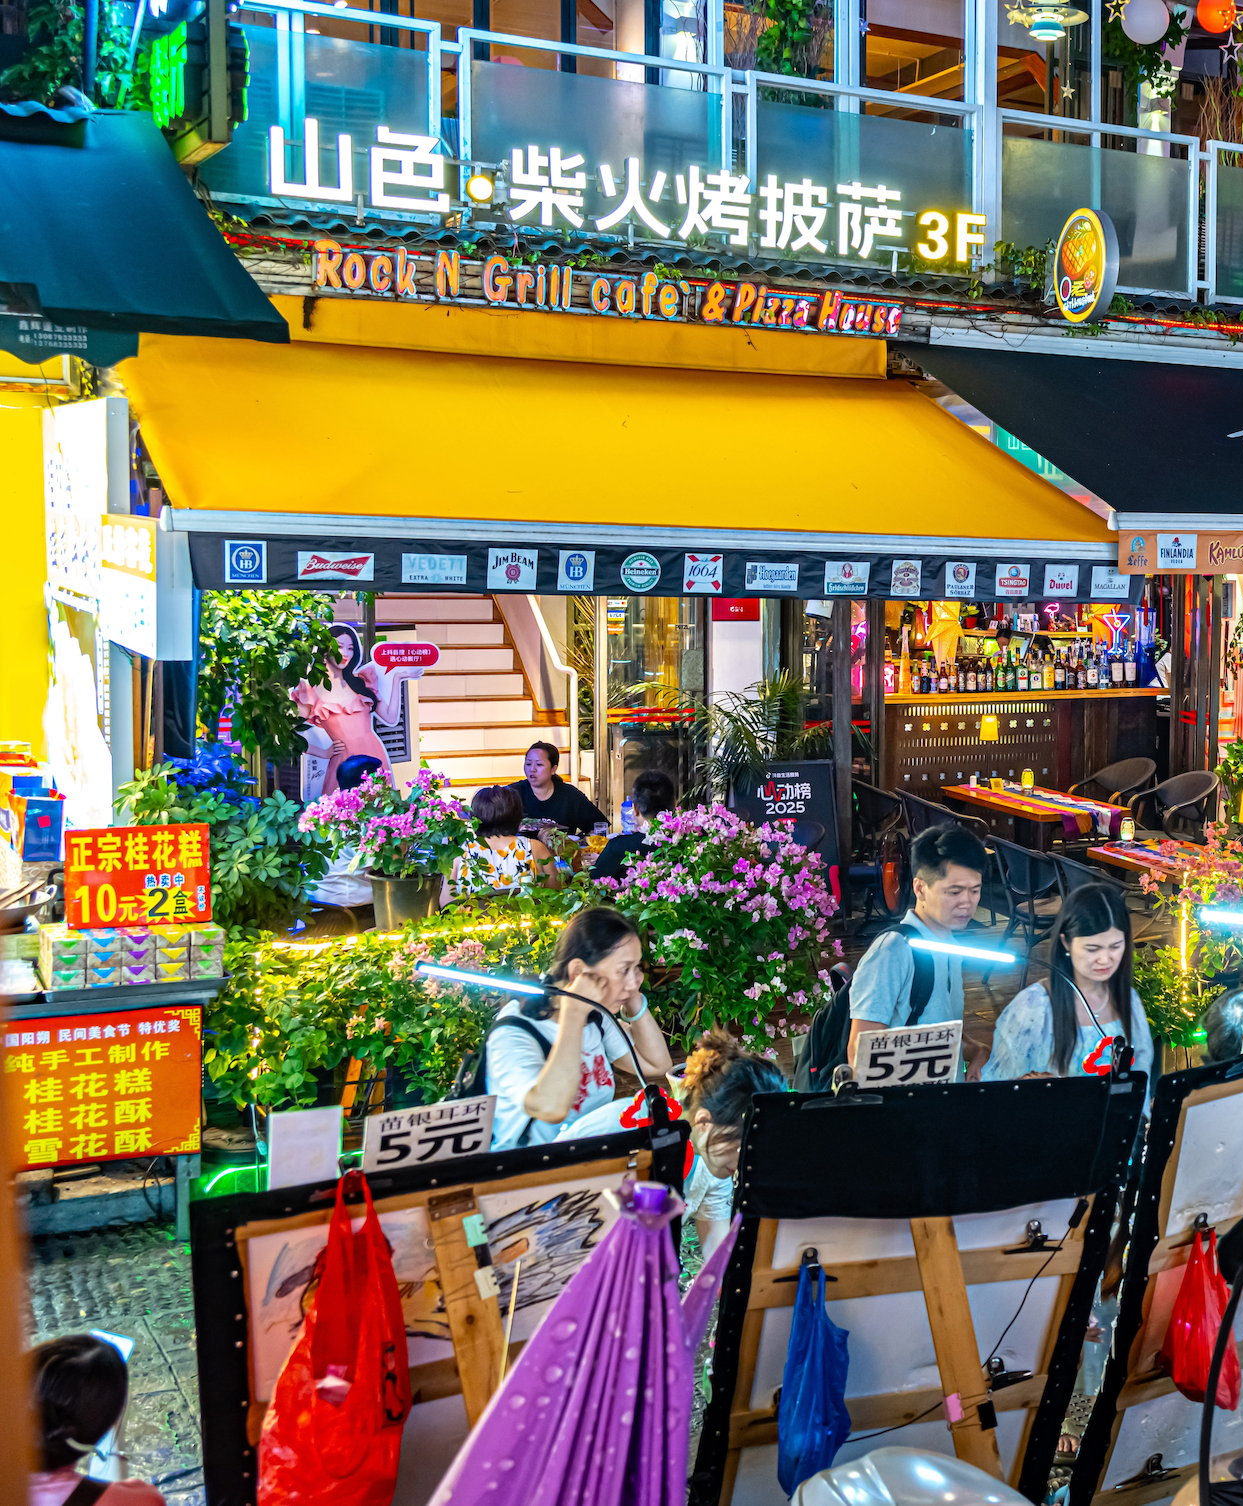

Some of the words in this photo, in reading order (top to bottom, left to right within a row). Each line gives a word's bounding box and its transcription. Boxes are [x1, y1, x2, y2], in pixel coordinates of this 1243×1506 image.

[269, 117, 450, 213] 山色
[508, 144, 902, 260] 柴火烤披萨
[916, 210, 987, 262] 3F
[315, 239, 416, 296] Rock
[436, 249, 461, 297] N
[484, 255, 573, 310] Grill
[702, 281, 728, 322] &
[733, 282, 810, 327] Pizza
[818, 290, 902, 334] House
[407, 554, 466, 572] VEDETT
[492, 556, 510, 570] JIM
[511, 552, 535, 571] BEAM
[1126, 554, 1148, 568] Leffe
[1160, 547, 1194, 559] FINLANDIA
[239, 558, 254, 569] HB
[569, 566, 584, 578] HB
[625, 567, 657, 576] Heineken
[688, 563, 718, 578] 1664
[759, 565, 797, 583] Hoegaarden
[1000, 579, 1027, 587] TSINGTAO
[1049, 579, 1073, 590] Duvel
[756, 780, 812, 802] 心动榜
[765, 801, 806, 815] 2025
[70, 830, 203, 873] 正宗桂花糕
[145, 873, 185, 888] 热卖中
[58, 1023, 131, 1043] 民间美食节
[138, 1019, 181, 1036] 特优奖
[870, 1028, 955, 1051] 苗银耳环
[4, 1040, 171, 1073] 纯手工制作
[866, 1044, 953, 1083] 5元
[23, 1067, 153, 1104] 桂花糕
[23, 1097, 153, 1134] 桂花酥
[380, 1101, 487, 1133] 苗银耳环
[23, 1127, 153, 1164] 雪花酥
[377, 1118, 484, 1165] 5元
